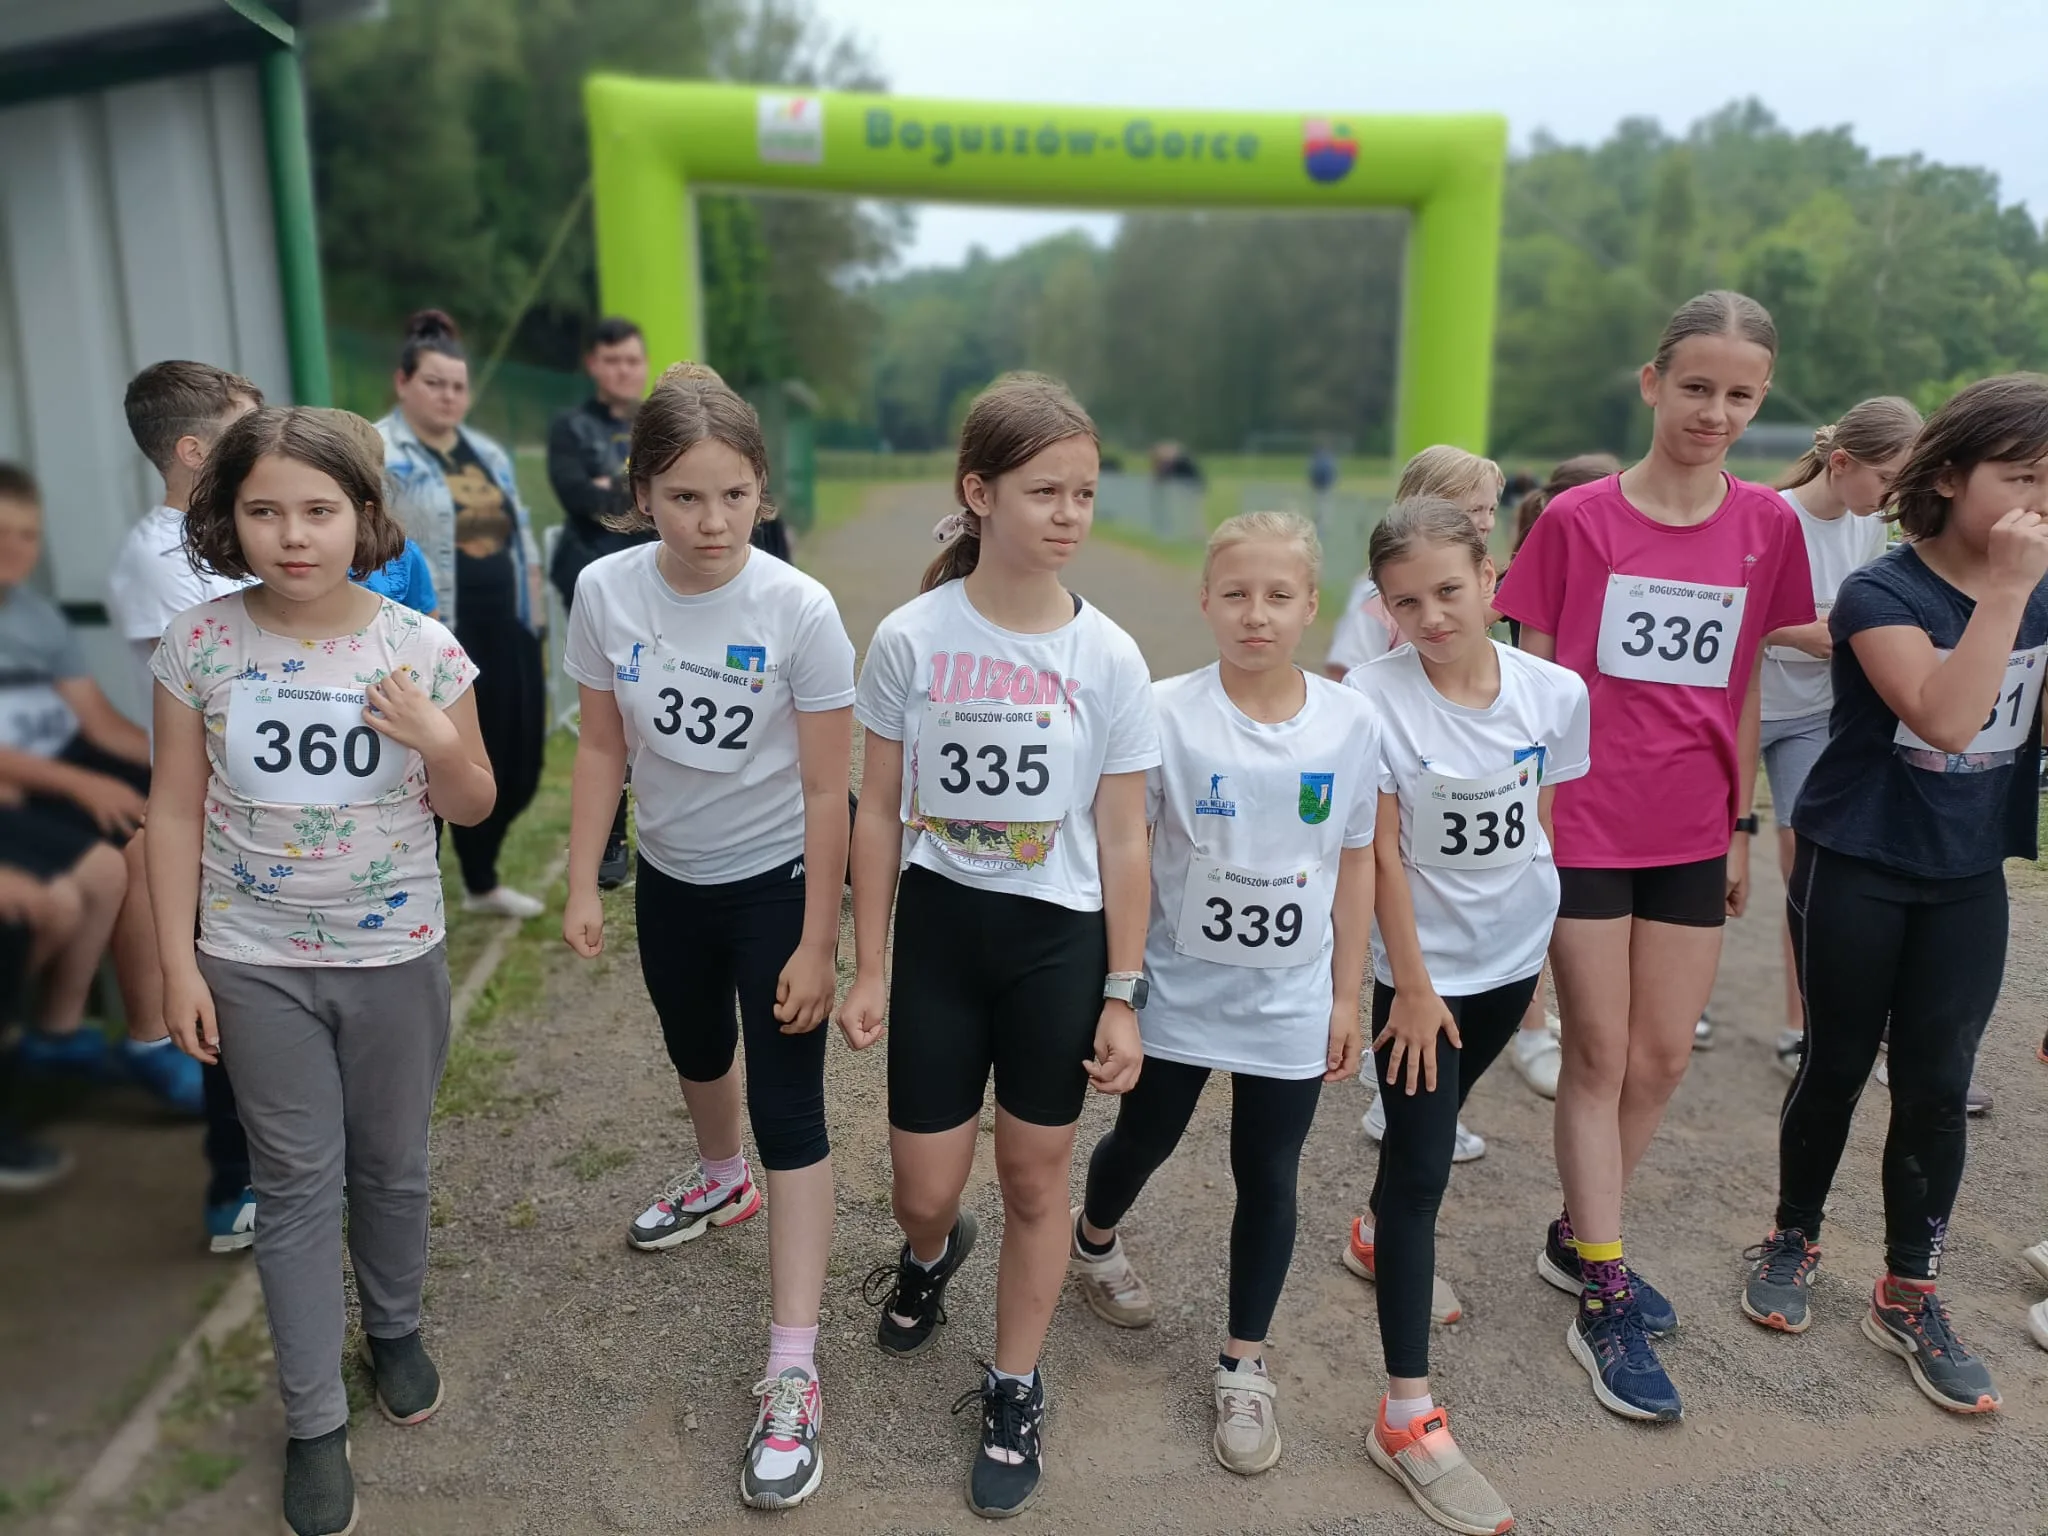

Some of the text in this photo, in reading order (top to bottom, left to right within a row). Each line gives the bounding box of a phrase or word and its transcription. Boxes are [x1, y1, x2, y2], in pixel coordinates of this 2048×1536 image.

[866, 109, 1260, 166] Boguszów-Gorce
[1648, 584, 1722, 601] BOGUSZÓW-GORCE
[1621, 611, 1723, 665] 336
[277, 687, 366, 705] BOGUSZÓW-GORCE
[679, 660, 749, 687] BOGUSZÓW-GORCE
[653, 687, 754, 750] 332
[954, 711, 1033, 723] BOGUSZÓW-GORCE
[253, 719, 381, 778] 360
[939, 742, 1050, 797] 335
[1451, 781, 1517, 801] BOGUSZÓW-GORCE
[1440, 801, 1526, 856] 338
[1225, 871, 1295, 887] BOGUSZÓW-GORCE
[1201, 896, 1303, 948] 339
